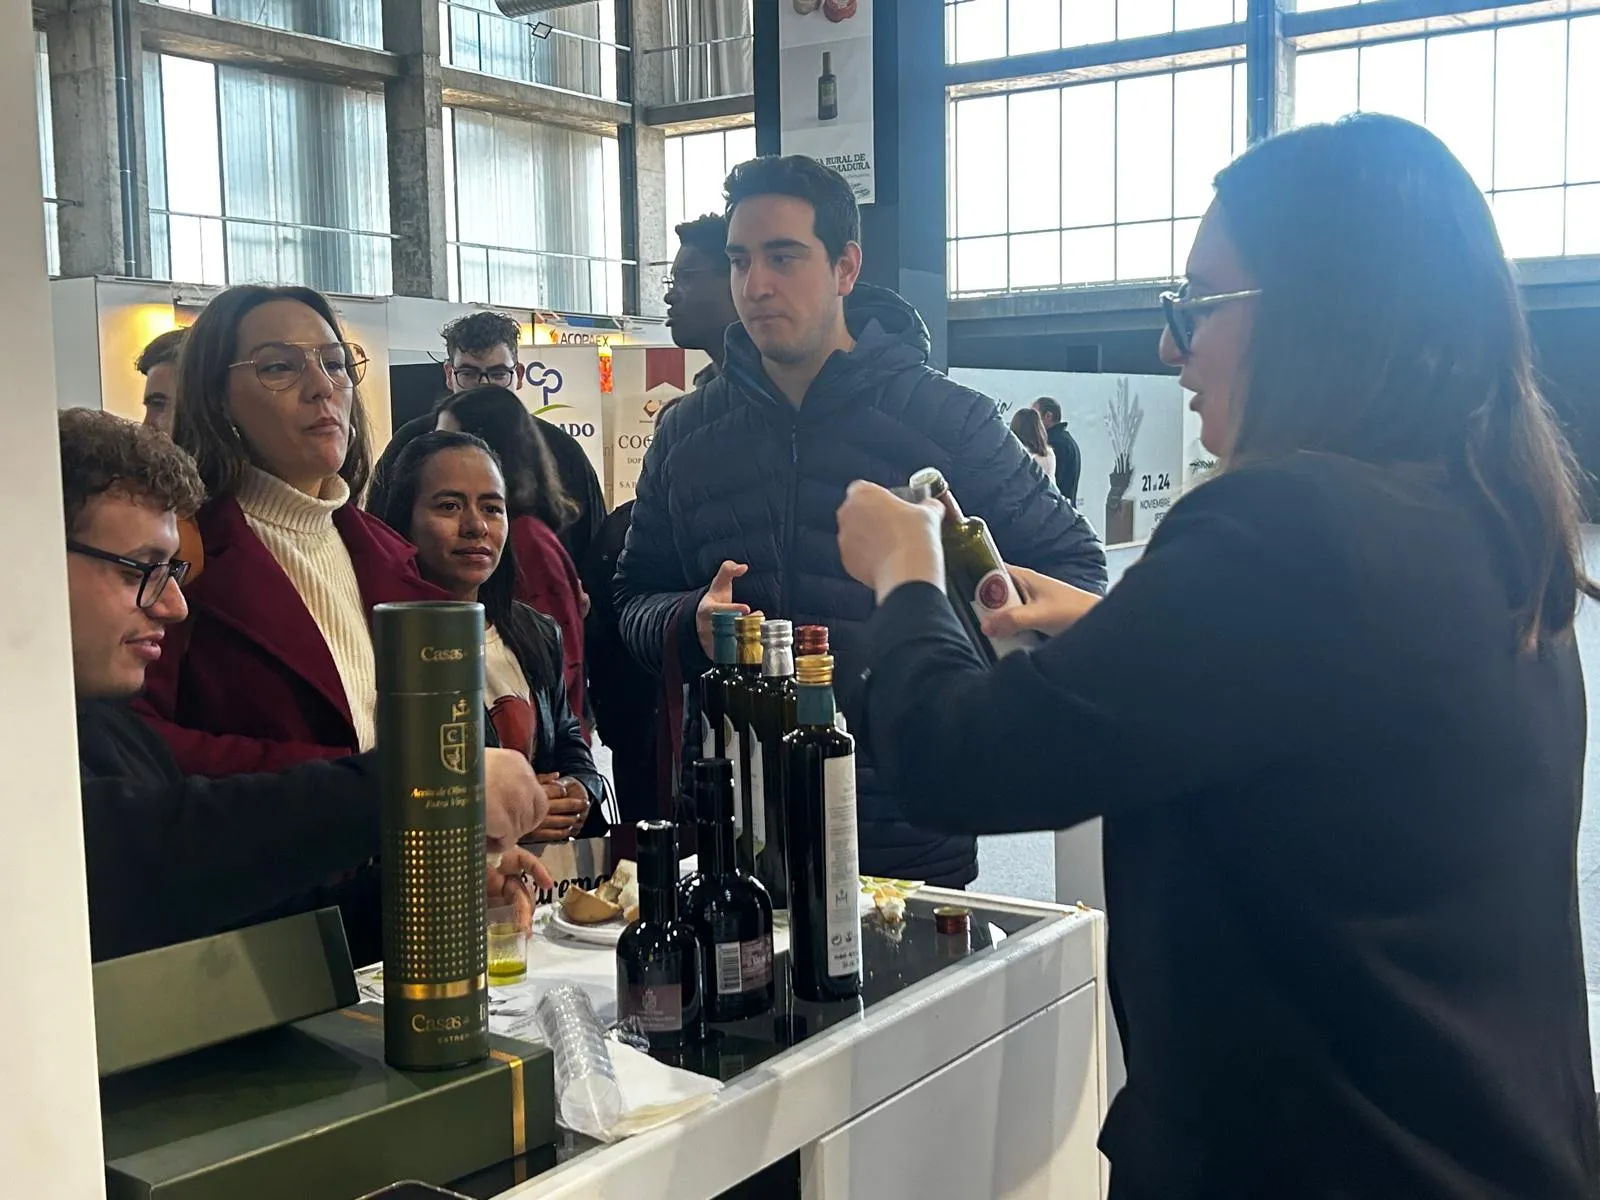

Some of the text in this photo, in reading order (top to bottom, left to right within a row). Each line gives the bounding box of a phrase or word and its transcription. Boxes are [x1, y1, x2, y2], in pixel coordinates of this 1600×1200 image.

[826, 155, 853, 166] RURAL
[854, 153, 866, 162] DE
[560, 332, 609, 347] ACOPAEX
[1142, 474, 1151, 492] 21
[1158, 473, 1170, 490] 24
[420, 646, 464, 662] Casas
